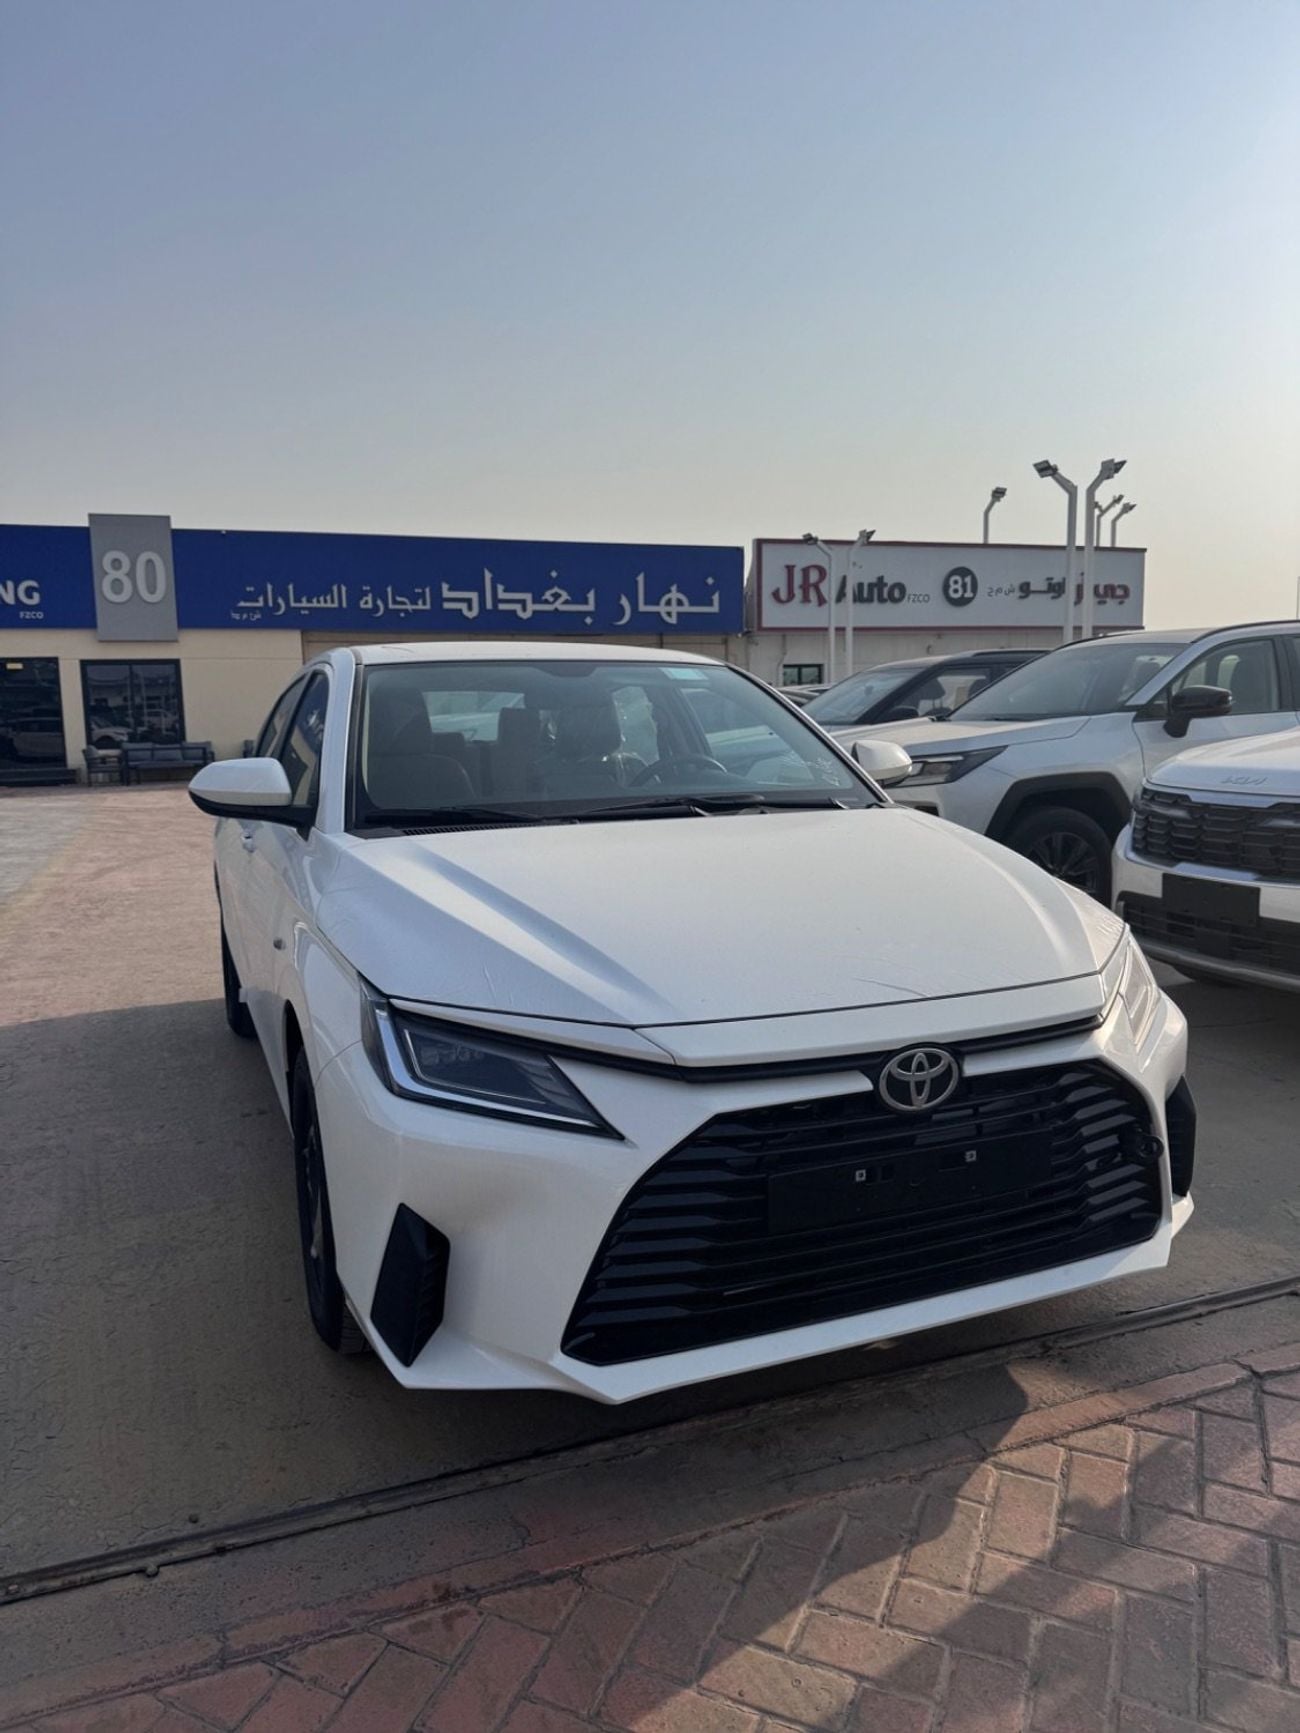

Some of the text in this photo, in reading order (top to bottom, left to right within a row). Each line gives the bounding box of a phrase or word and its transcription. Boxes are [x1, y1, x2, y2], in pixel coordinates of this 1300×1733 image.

[0, 580, 41, 605] NG
[101, 550, 167, 603] 80
[771, 564, 828, 607] JR
[835, 574, 907, 604] Auto
[948, 575, 974, 599] 81
[237, 568, 720, 625] نهار بغداد لتجارة السيارات
[19, 611, 44, 619] FZCO
